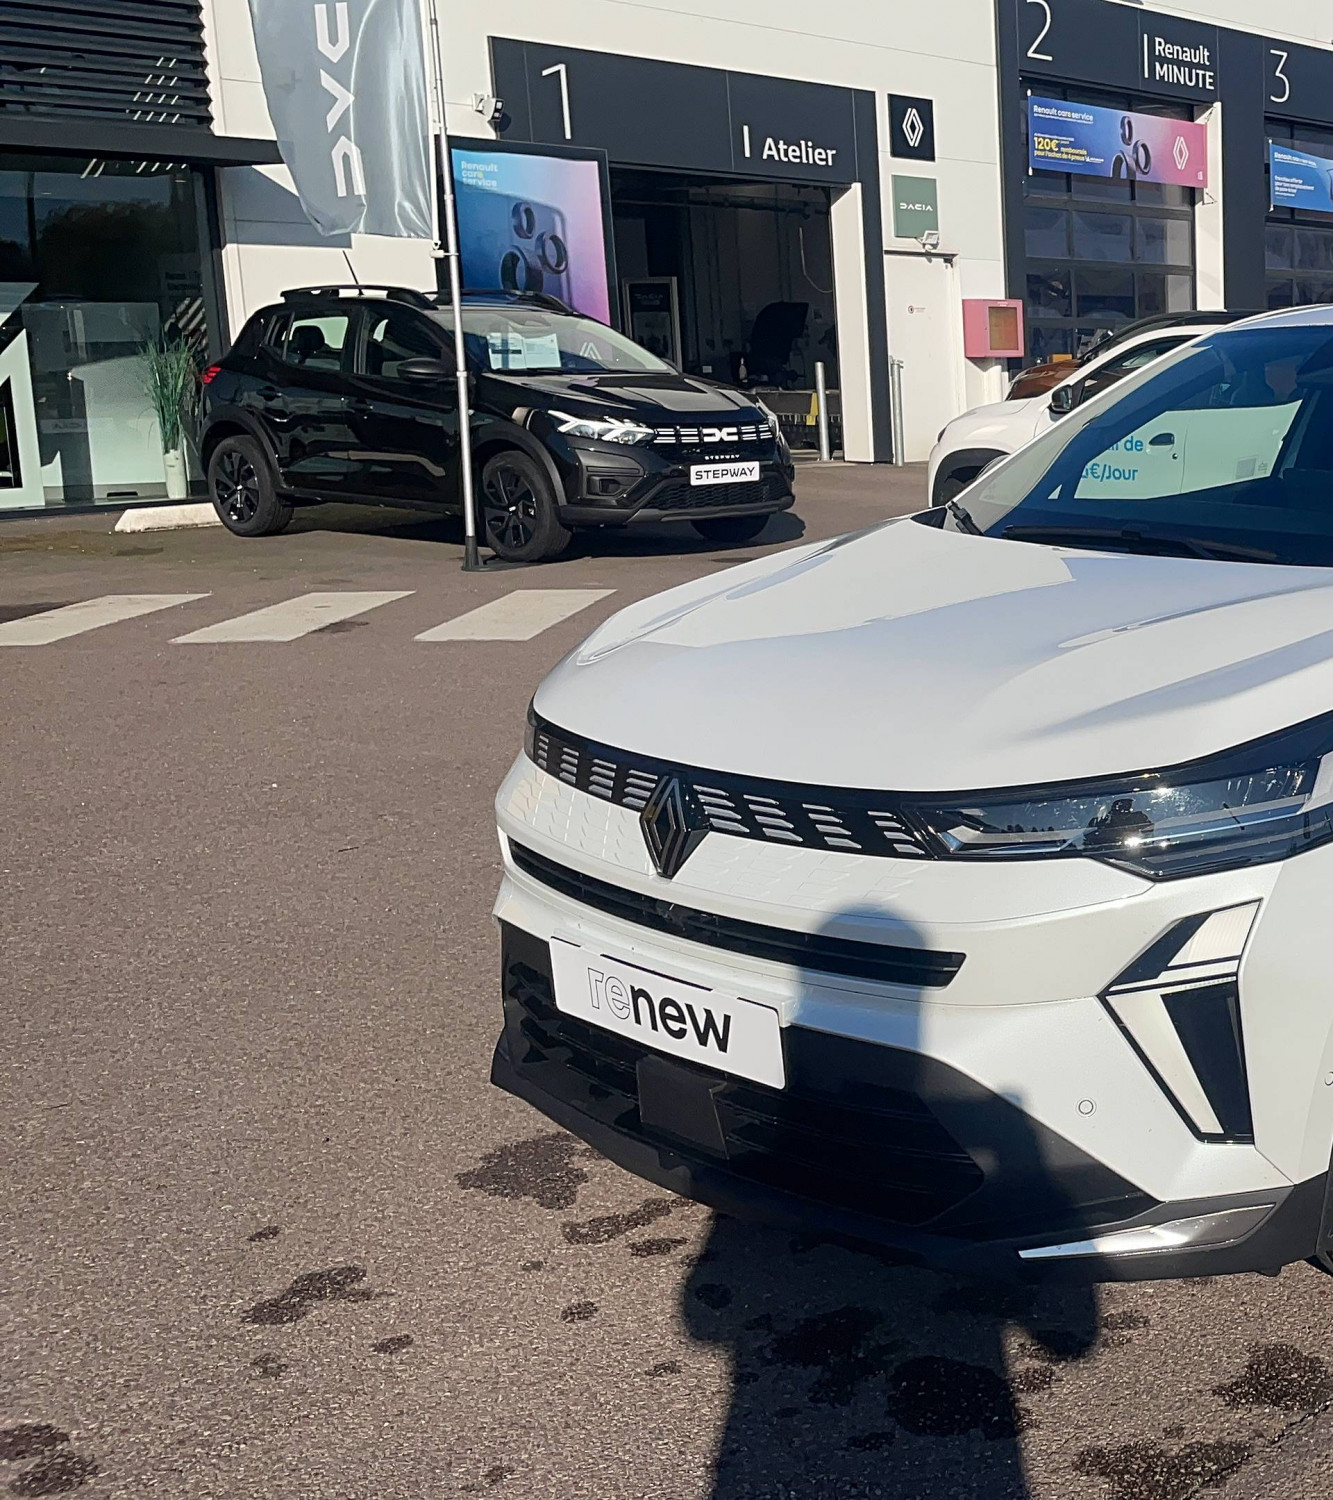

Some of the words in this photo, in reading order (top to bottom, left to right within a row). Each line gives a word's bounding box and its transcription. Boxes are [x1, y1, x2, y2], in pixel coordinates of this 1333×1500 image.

[1026, 0, 1053, 61] 2
[1154, 36, 1210, 66] Renault
[1155, 61, 1215, 90] MINUTE
[1270, 49, 1290, 103] 3
[541, 63, 572, 140] 1
[1033, 104, 1057, 116] Renault
[1072, 111, 1094, 121] service
[762, 137, 837, 166] Atelier
[1034, 136, 1059, 151] 120€
[461, 160, 498, 172] Renault
[462, 170, 484, 179] care
[462, 177, 498, 187] service
[899, 202, 934, 212] DACIA
[1123, 435, 1144, 452] de
[695, 466, 756, 480] STEPWAY
[587, 966, 732, 1054] renew
